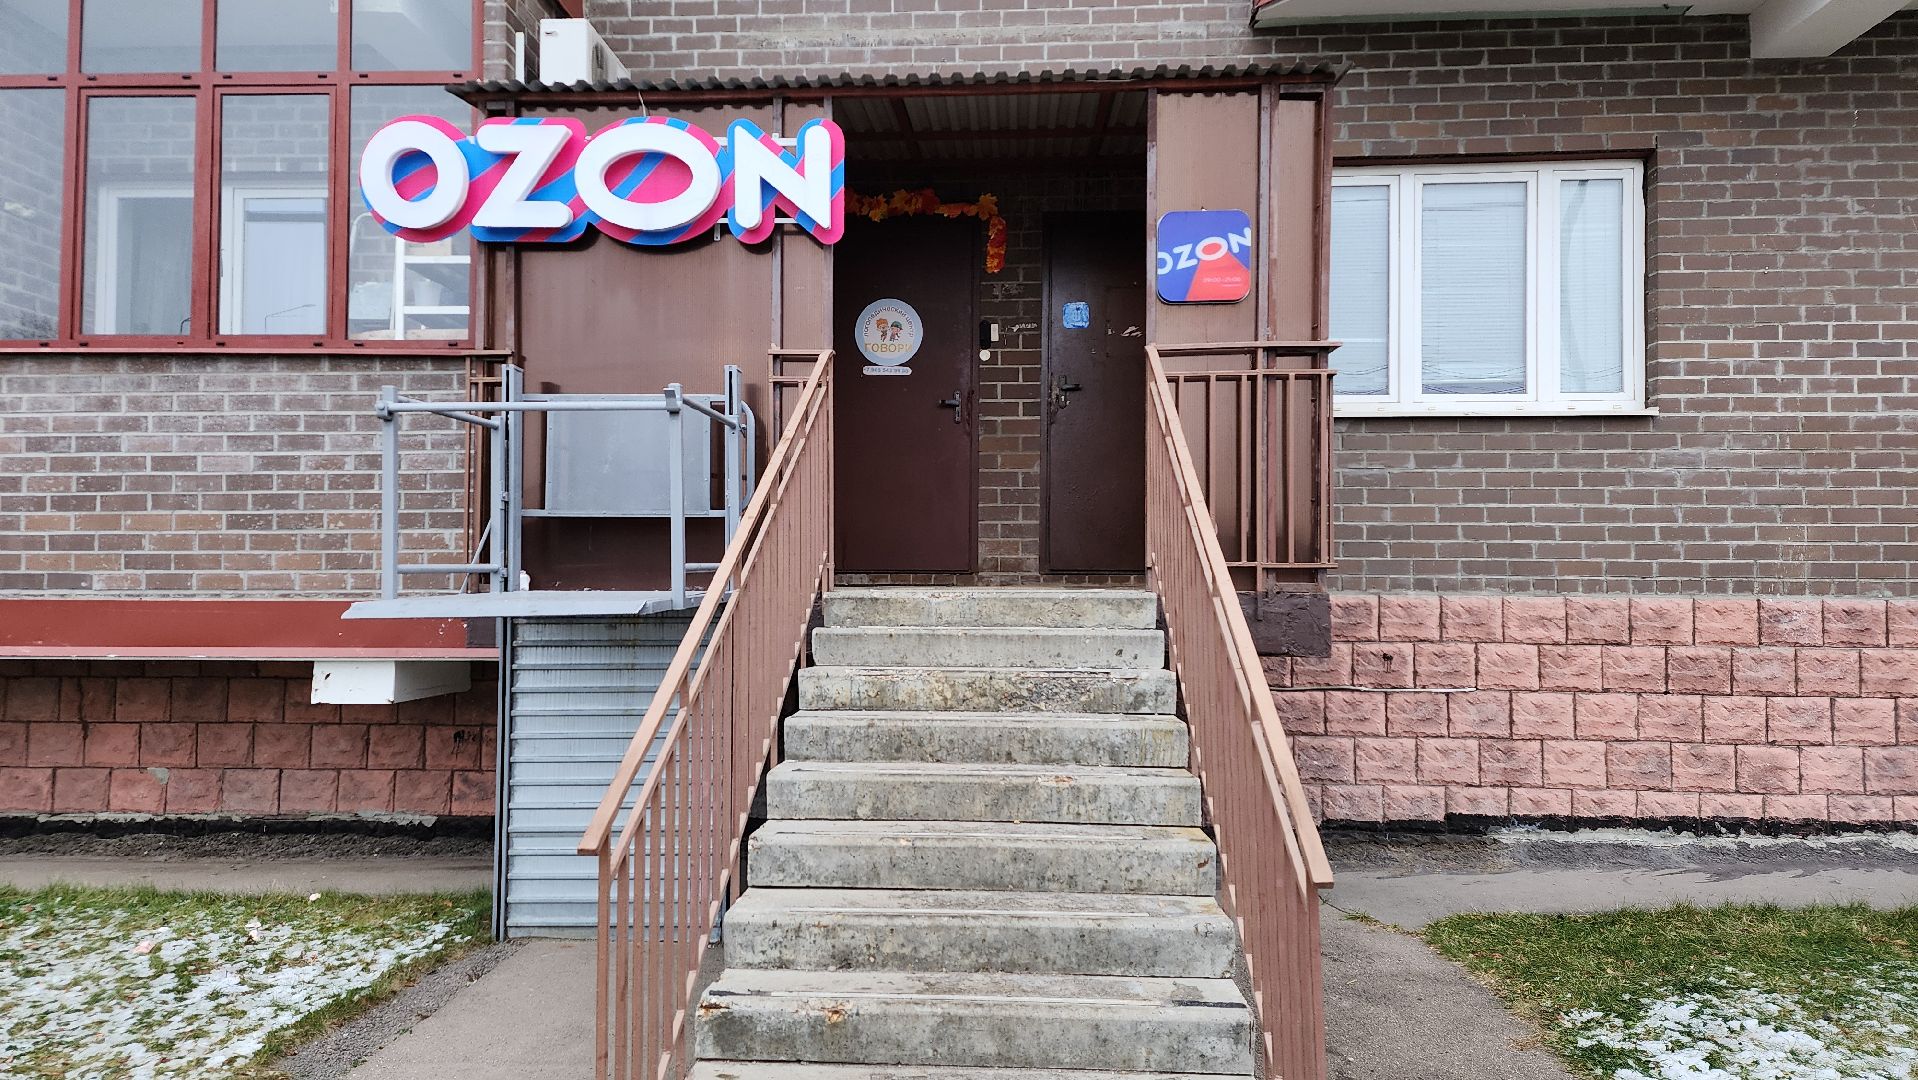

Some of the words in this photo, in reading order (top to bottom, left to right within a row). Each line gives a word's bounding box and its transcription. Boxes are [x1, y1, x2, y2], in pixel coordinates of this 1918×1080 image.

[360, 119, 833, 232] OZON
[1157, 227, 1251, 275] OZON
[864, 343, 913, 353] ГОВОРИ
